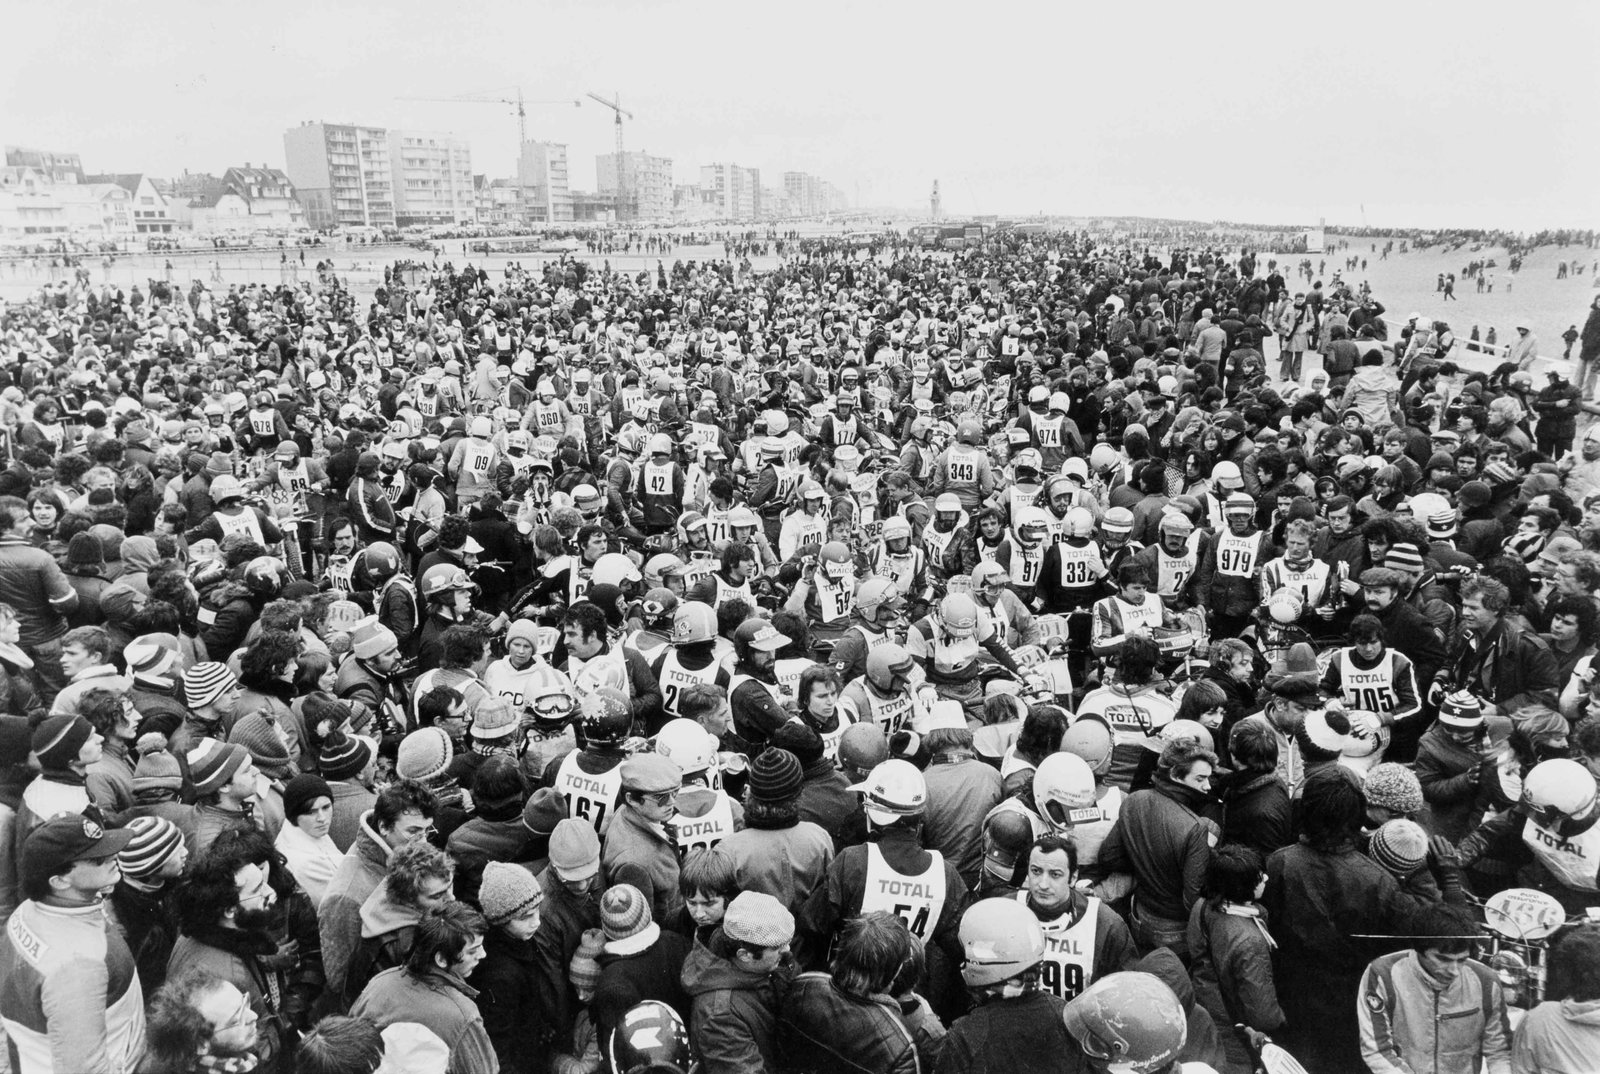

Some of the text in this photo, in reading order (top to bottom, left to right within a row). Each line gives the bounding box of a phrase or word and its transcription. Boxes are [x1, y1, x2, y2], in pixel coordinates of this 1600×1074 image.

[578, 402, 588, 413] 29
[540, 411, 558, 425] 360
[253, 420, 271, 432] 978
[1039, 429, 1056, 444] 974
[474, 455, 488, 470] 09
[951, 463, 972, 480] 343
[290, 478, 306, 491] 88
[651, 476, 664, 491] 42
[271, 490, 288, 503] 88
[711, 523, 726, 540] 71
[927, 530, 943, 544] TOTAL
[1225, 539, 1251, 548] TOTAL
[1015, 550, 1039, 558] TOTAL
[1067, 550, 1094, 558] TOTAL
[1221, 549, 1251, 573] 979
[1022, 560, 1038, 582] 91
[1164, 560, 1192, 568] TOTAL
[1286, 572, 1318, 581] TOTAL
[721, 588, 746, 598] TOTAL
[835, 590, 850, 615] 59
[1126, 608, 1154, 619] TOTAL
[1348, 672, 1387, 683] TOTAL
[1349, 686, 1394, 711] 705
[878, 698, 906, 715] TOTA
[1109, 711, 1149, 724] TOTAL
[566, 773, 608, 796] TOTAL
[566, 793, 606, 834] 167
[1072, 808, 1098, 820] TOTAL
[676, 820, 722, 837] TOTAL
[1534, 827, 1586, 859] TOTAL
[878, 879, 933, 899] TOTAL
[893, 903, 932, 938] 54
[11, 914, 40, 958] ONDA
[1044, 936, 1083, 955] TAL
[1042, 960, 1083, 1000] 99
[1129, 1049, 1171, 1068] Daytona
